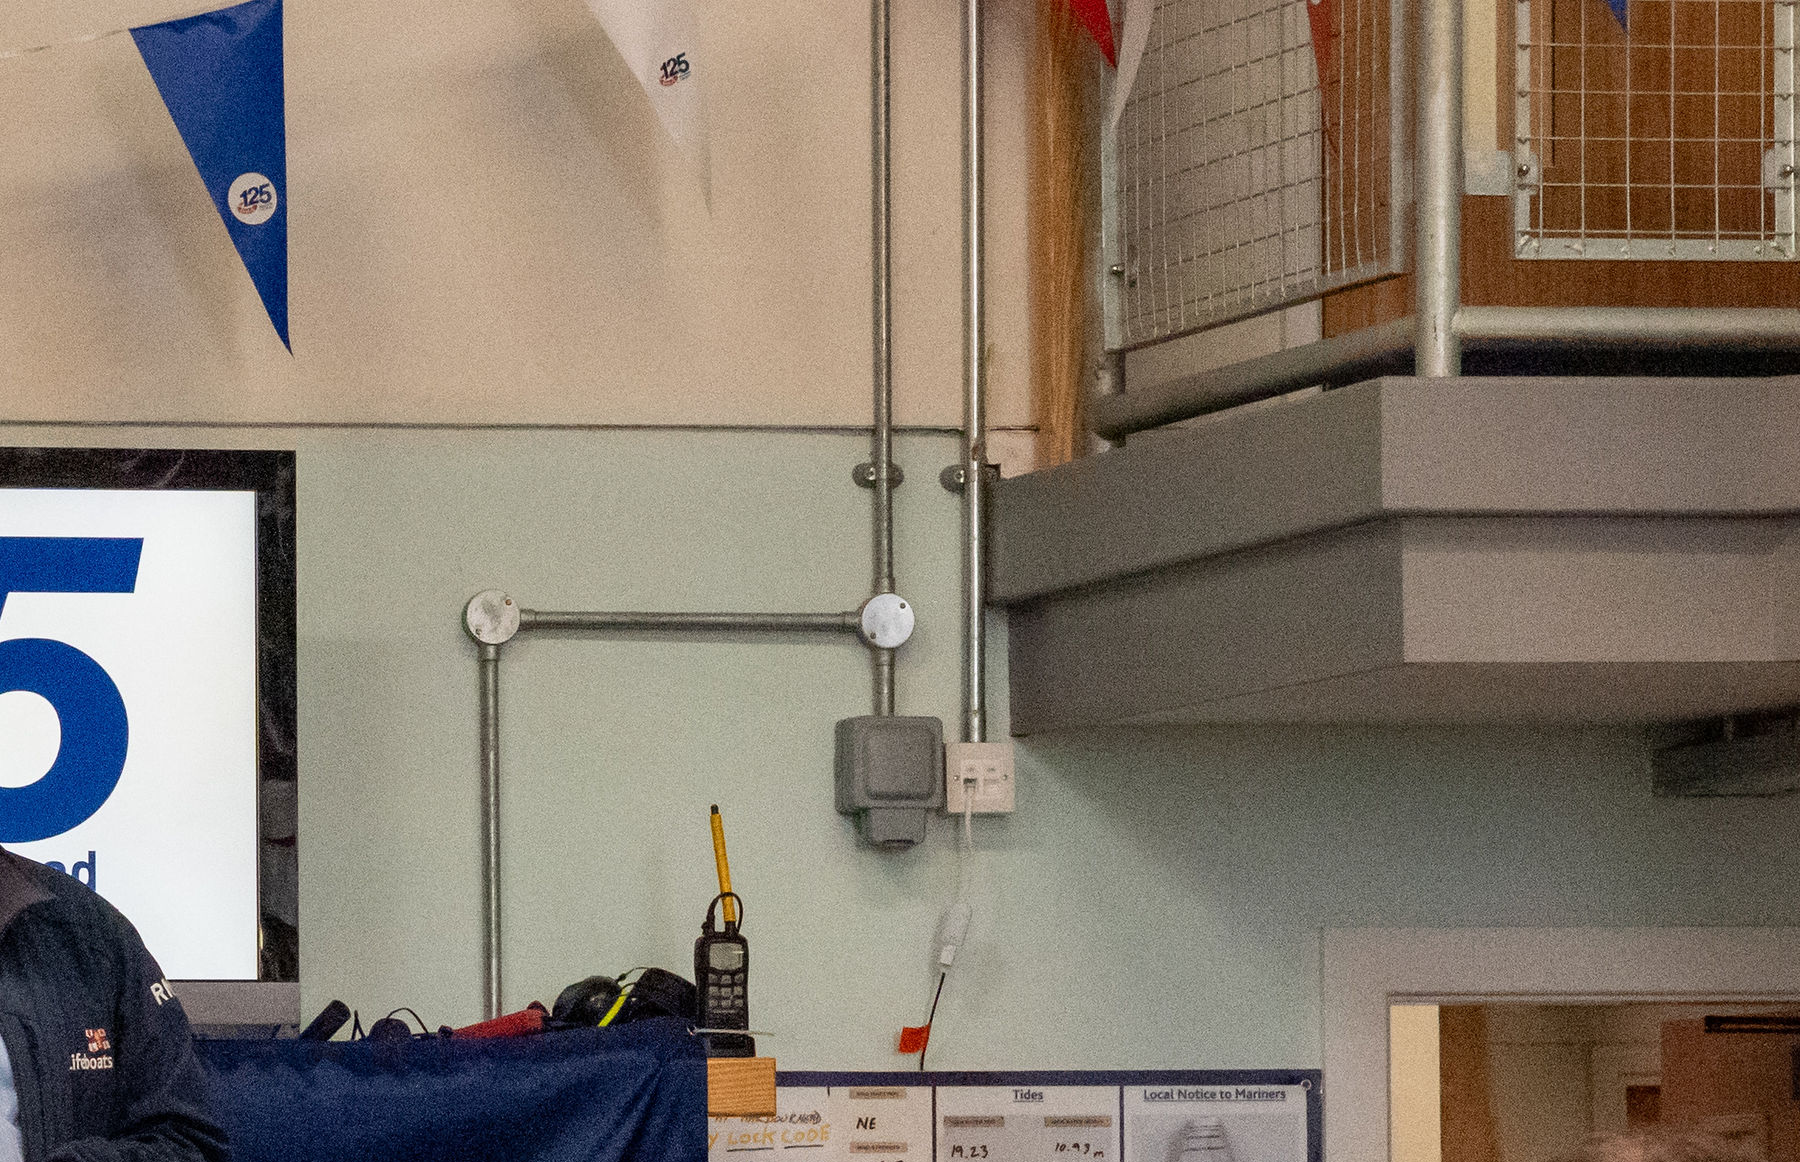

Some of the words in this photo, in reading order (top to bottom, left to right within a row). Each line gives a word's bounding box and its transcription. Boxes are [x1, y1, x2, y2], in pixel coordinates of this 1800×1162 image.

[660, 52, 689, 79] 125
[240, 183, 272, 207] 125
[1013, 1089, 1044, 1100] Tides
[1144, 1089, 1174, 1100] Local
[1178, 1089, 1216, 1099] Notice
[1220, 1090, 1231, 1099] to
[1235, 1088, 1286, 1099] Mariners
[856, 1117, 877, 1130] NE
[951, 1144, 989, 1159] 19.23
